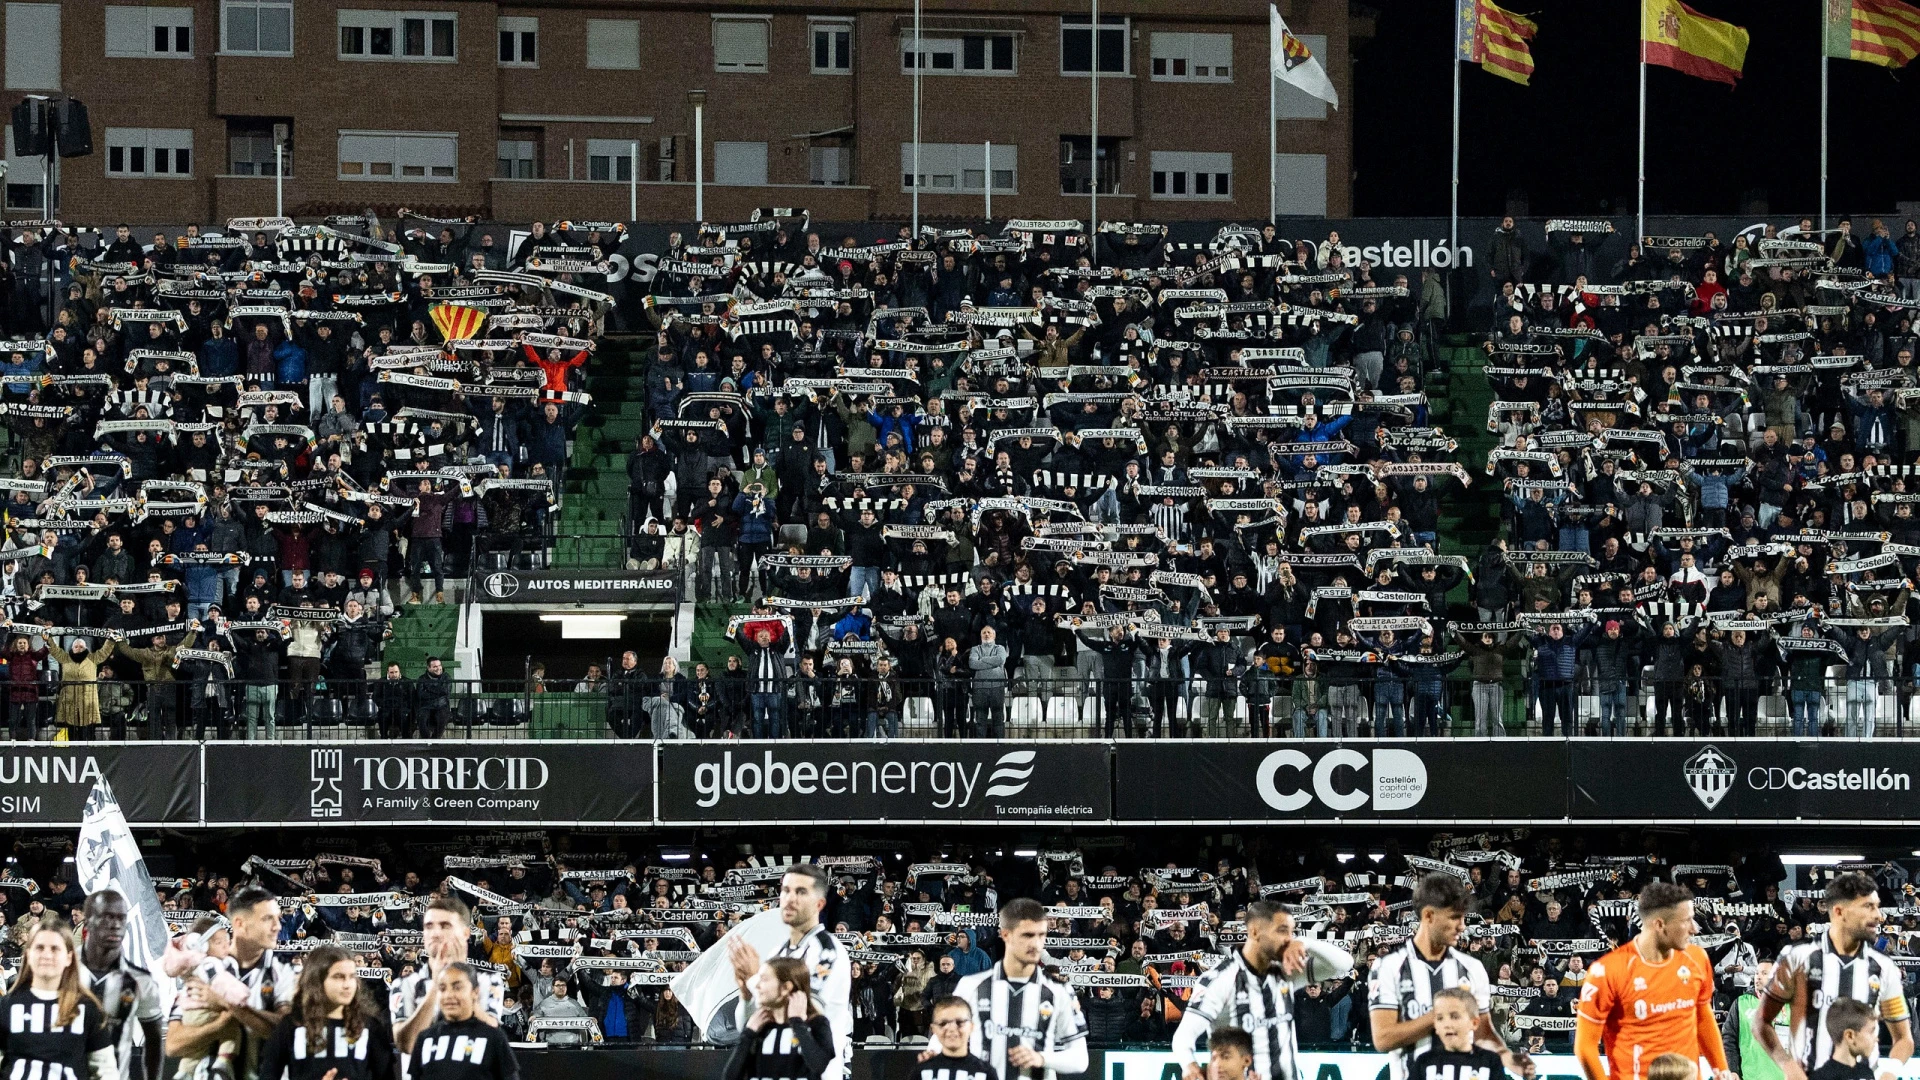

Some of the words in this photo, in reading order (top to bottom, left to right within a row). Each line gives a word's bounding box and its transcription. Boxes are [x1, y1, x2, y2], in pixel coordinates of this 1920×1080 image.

[1023, 231, 1031, 240] P
[1045, 234, 1053, 243] A
[1066, 236, 1076, 245] M
[1656, 237, 1706, 246] CDCastellón
[1279, 239, 1473, 268] astellón
[672, 265, 722, 275] ALBINEGRA
[438, 286, 489, 297] CDCastellón
[394, 374, 450, 389] CDCastellón
[464, 386, 482, 394] C.D.
[688, 420, 716, 428] ORELLUT
[1715, 458, 1744, 466] ORELLUT
[236, 487, 281, 495] CDCastellón
[1216, 500, 1273, 509] CDCastellón
[179, 551, 222, 559] CDCastellón
[1282, 555, 1300, 563] C.D.
[528, 579, 571, 590] AUTOS
[574, 577, 673, 590] MEDITERRÁNEO
[1158, 576, 1192, 585] ORELLUT
[1634, 587, 1648, 595] LATE
[293, 610, 337, 619] CASTELLÓN
[1761, 608, 1806, 620] CDCastellón
[1096, 618, 1129, 627] ORELLUT
[1719, 620, 1765, 629] CDCastellón
[141, 627, 155, 636] PAM
[156, 622, 184, 634] ORELLUT
[1148, 630, 1182, 638] ORELLUT
[1317, 648, 1361, 657] CDCastellón
[354, 757, 549, 790] TORRECID
[694, 750, 983, 809] globeenergy
[1256, 749, 1427, 811] CCD
[1379, 775, 1417, 784] Castellón
[1748, 766, 1910, 791] CDCastellón
[1379, 784, 1407, 793] capital
[1409, 784, 1423, 792] del
[1379, 792, 1412, 800] deporte
[363, 798, 374, 808] A
[377, 797, 419, 811] Family
[422, 797, 432, 808] &
[434, 797, 471, 808] Green
[475, 797, 540, 811] Company
[995, 805, 1006, 814] Tu
[1008, 803, 1051, 815] compañía
[1055, 803, 1093, 814] eléctrica
[324, 894, 387, 905] CDCastellón
[655, 910, 709, 921] CDCastellón
[1074, 974, 1141, 985] CDCastellón
[1650, 999, 1695, 1013] LayerZero
